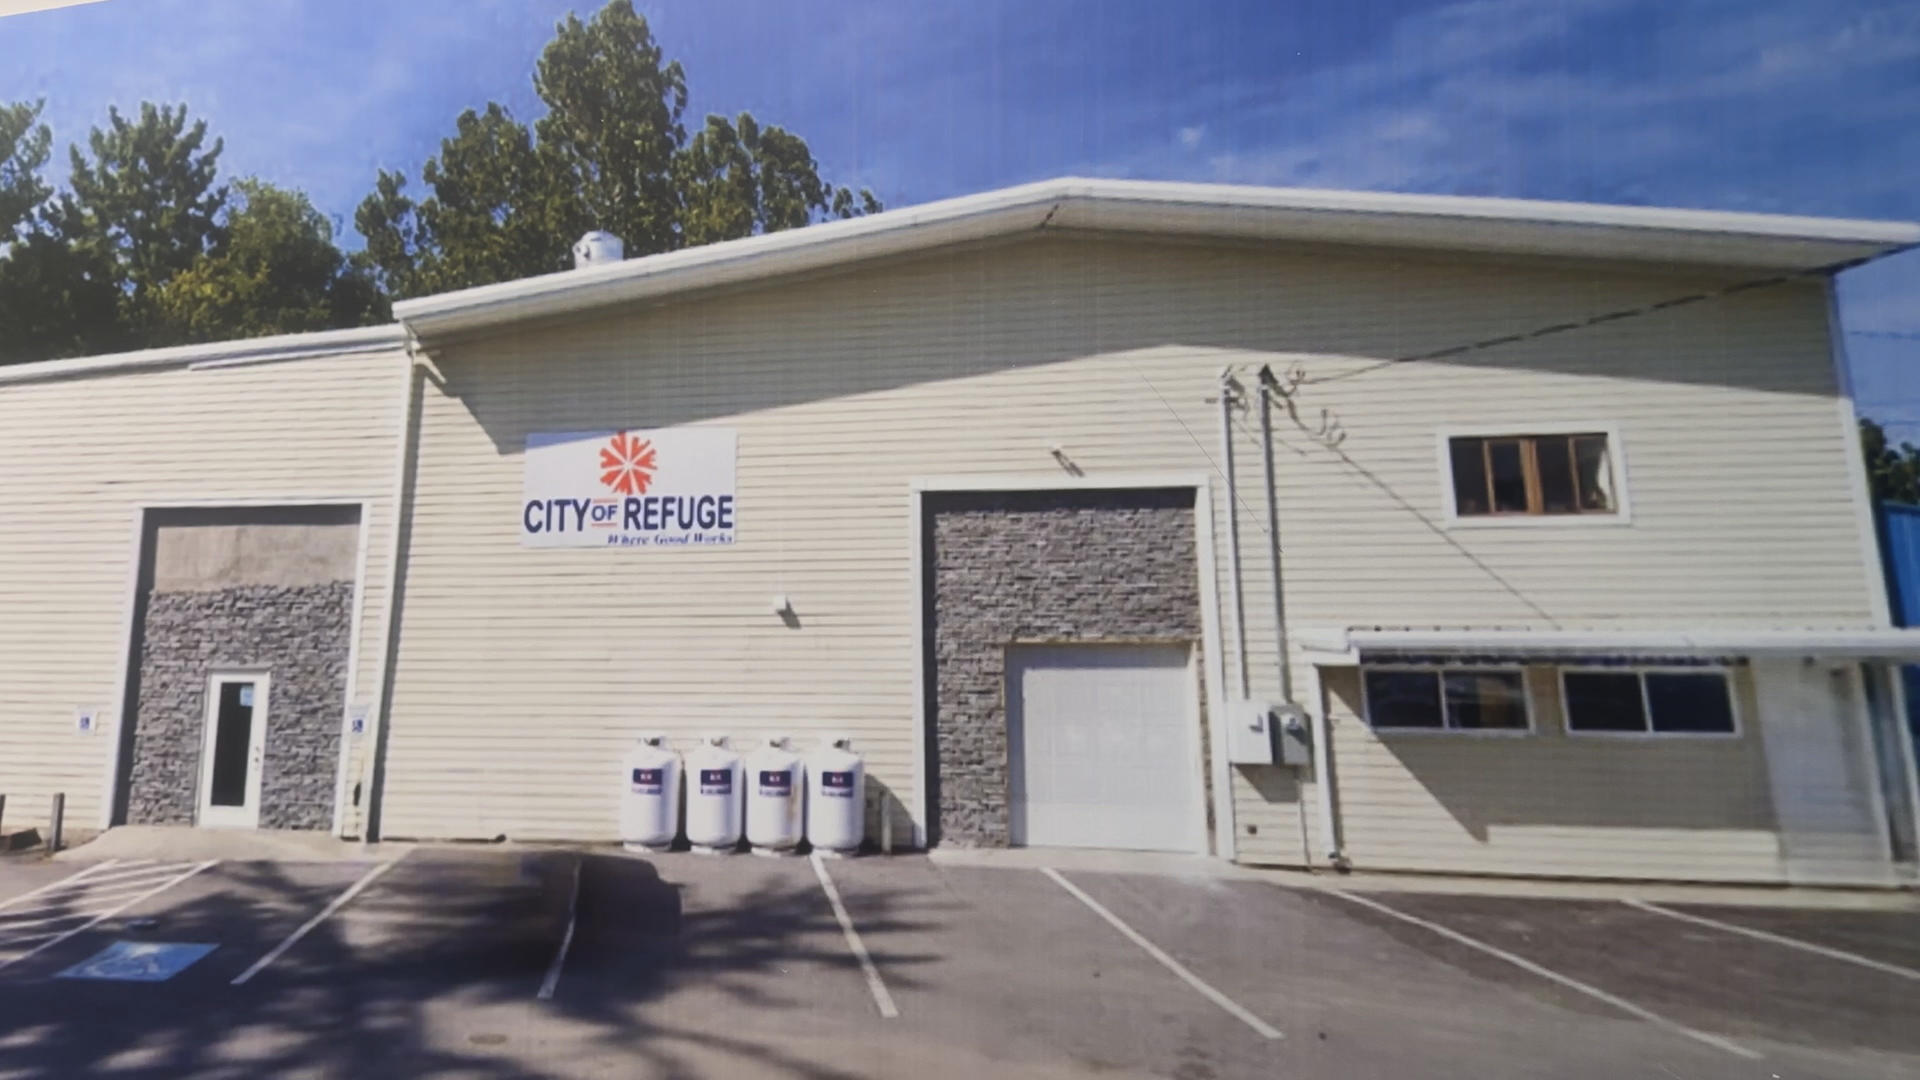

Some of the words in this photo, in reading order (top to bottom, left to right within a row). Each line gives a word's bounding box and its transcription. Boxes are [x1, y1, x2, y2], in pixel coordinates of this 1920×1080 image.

[524, 498, 591, 533] CITY
[592, 505, 618, 522] OF
[623, 495, 733, 530] REFUGE
